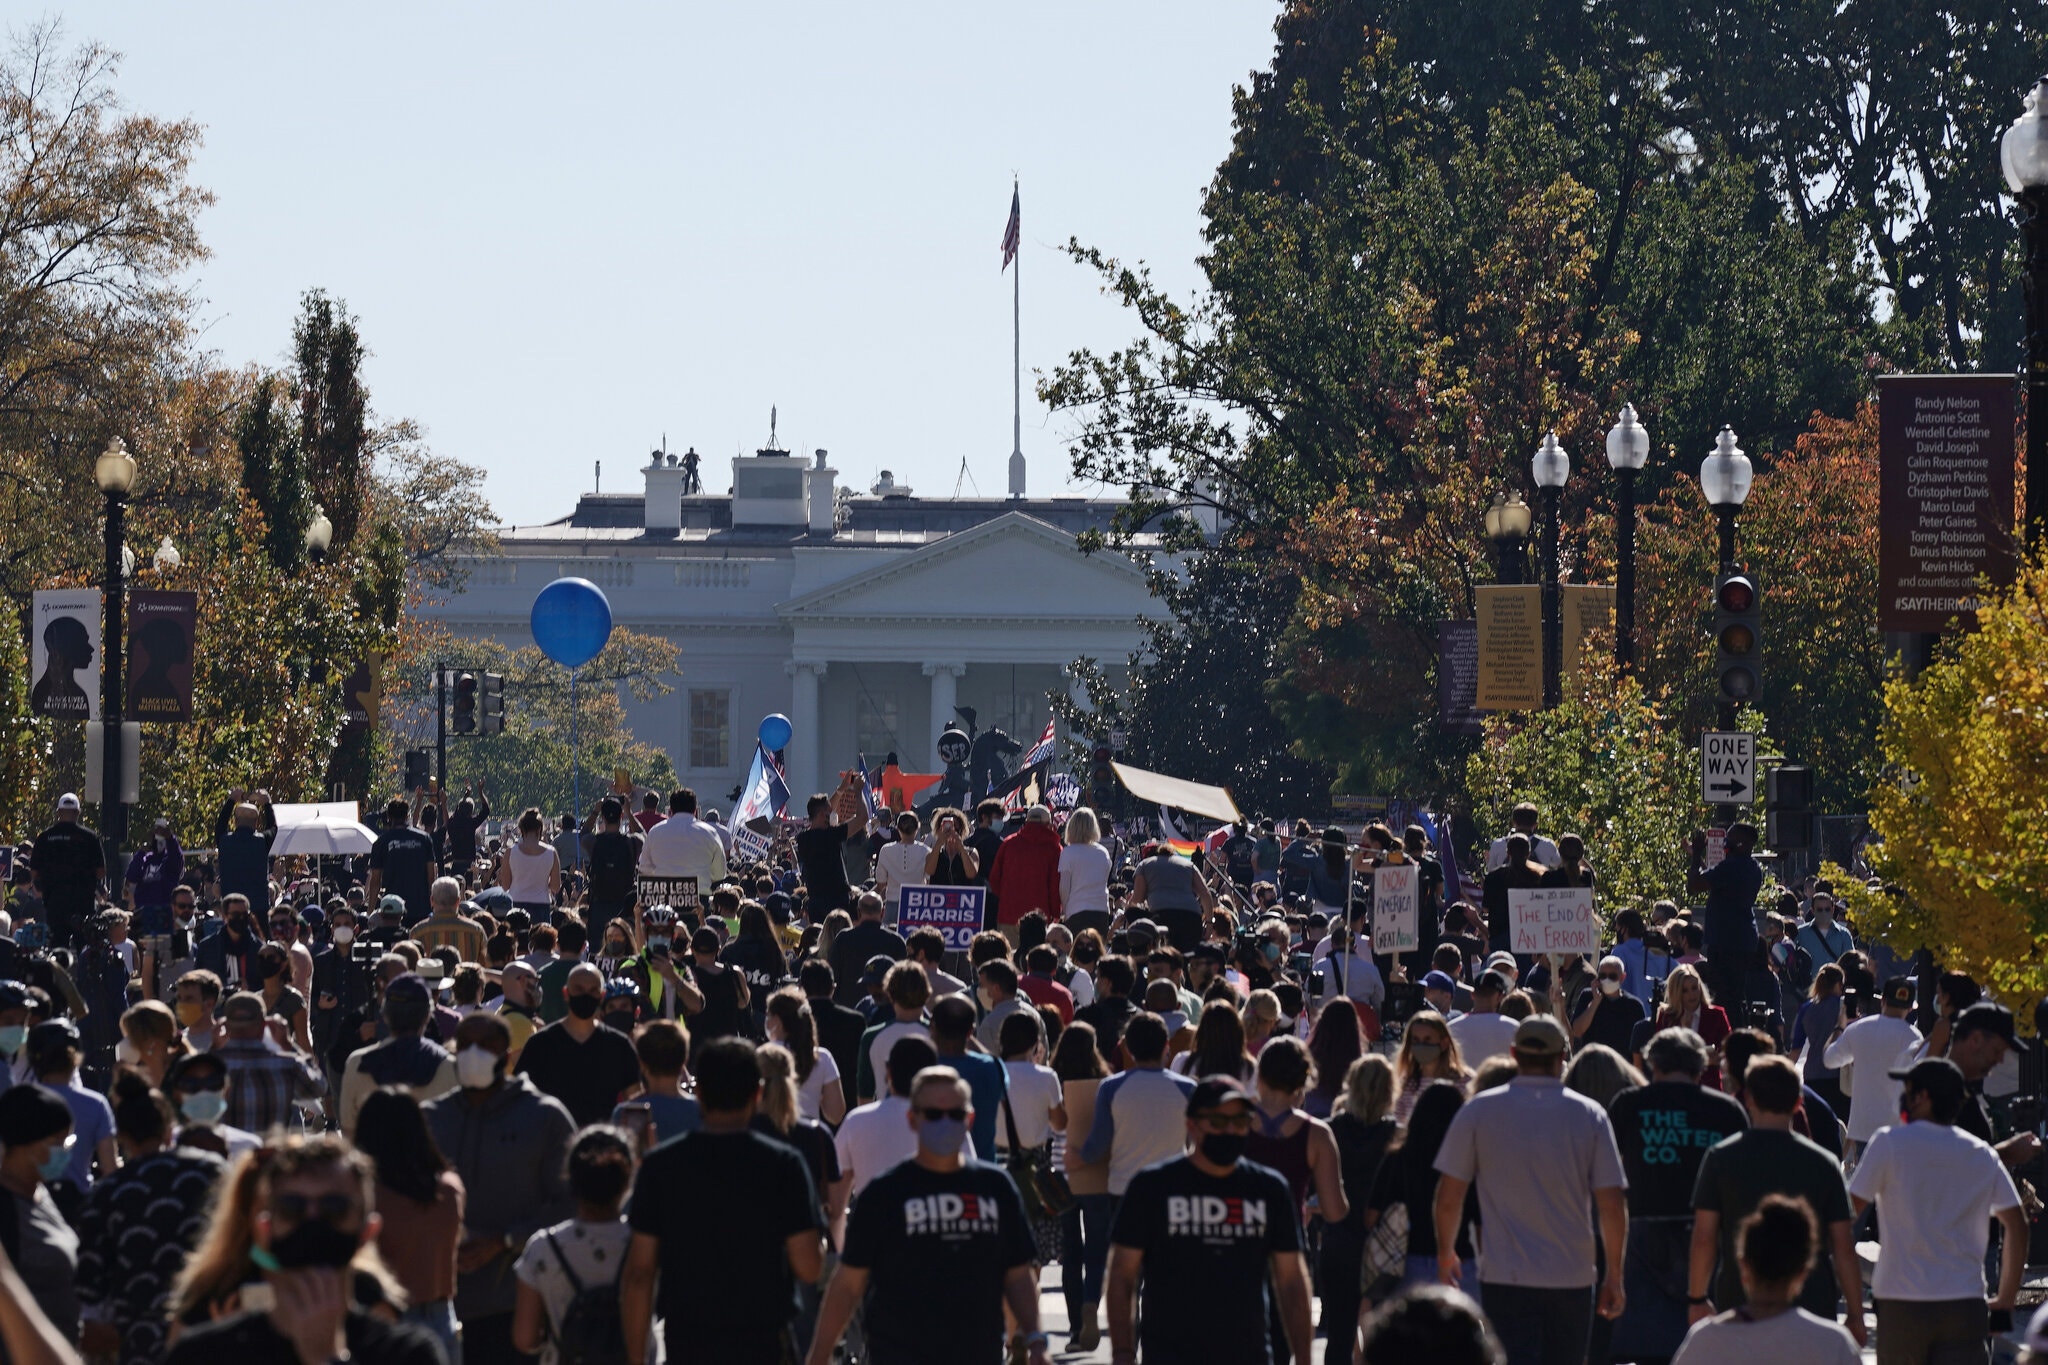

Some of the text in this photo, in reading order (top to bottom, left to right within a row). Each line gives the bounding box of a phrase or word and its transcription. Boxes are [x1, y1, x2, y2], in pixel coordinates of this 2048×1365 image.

[1915, 397, 1980, 412] Randy Nelson
[1914, 412, 1980, 424] Antronie Scott
[1905, 426, 1990, 438] Wendell Celestine
[1916, 441, 1979, 455] David Joseph
[1907, 456, 1989, 471] Calin Roquemore
[1908, 470, 1988, 486] Dyzhawn Perkins
[1907, 486, 1989, 500] Christopher Davis
[1921, 501, 1975, 513] Marco Loud
[1919, 516, 1977, 528] Peter Gaines
[1910, 530, 1985, 545] Torrey Robinson
[1910, 546, 1986, 558] Darius Robinson
[1921, 560, 1975, 572] Kevin Hicks
[1898, 576, 1916, 588] and
[1918, 576, 1960, 588] countless
[1710, 738, 1748, 755] ONE
[1708, 758, 1749, 775] WAY
[1382, 869, 1409, 890] NOW
[640, 881, 696, 894] FEAR LESS
[639, 894, 698, 907] LOVE MORE
[908, 892, 976, 909] BIDEN
[1377, 895, 1411, 914] AMERICA
[907, 908, 974, 922] HARRIS
[1516, 903, 1591, 924] THE END OF
[906, 925, 973, 946] 20
[1517, 928, 1536, 949] AN
[742, 967, 771, 986] ote
[1638, 1110, 1688, 1128] THE
[1640, 1128, 1722, 1148] WATER
[1643, 1146, 1682, 1164] CO.
[904, 1193, 999, 1223] BIDEN
[1168, 1195, 1267, 1224] BIDEN
[906, 1220, 999, 1236] PRESIDENT
[1168, 1224, 1266, 1238] PRESIDENT
